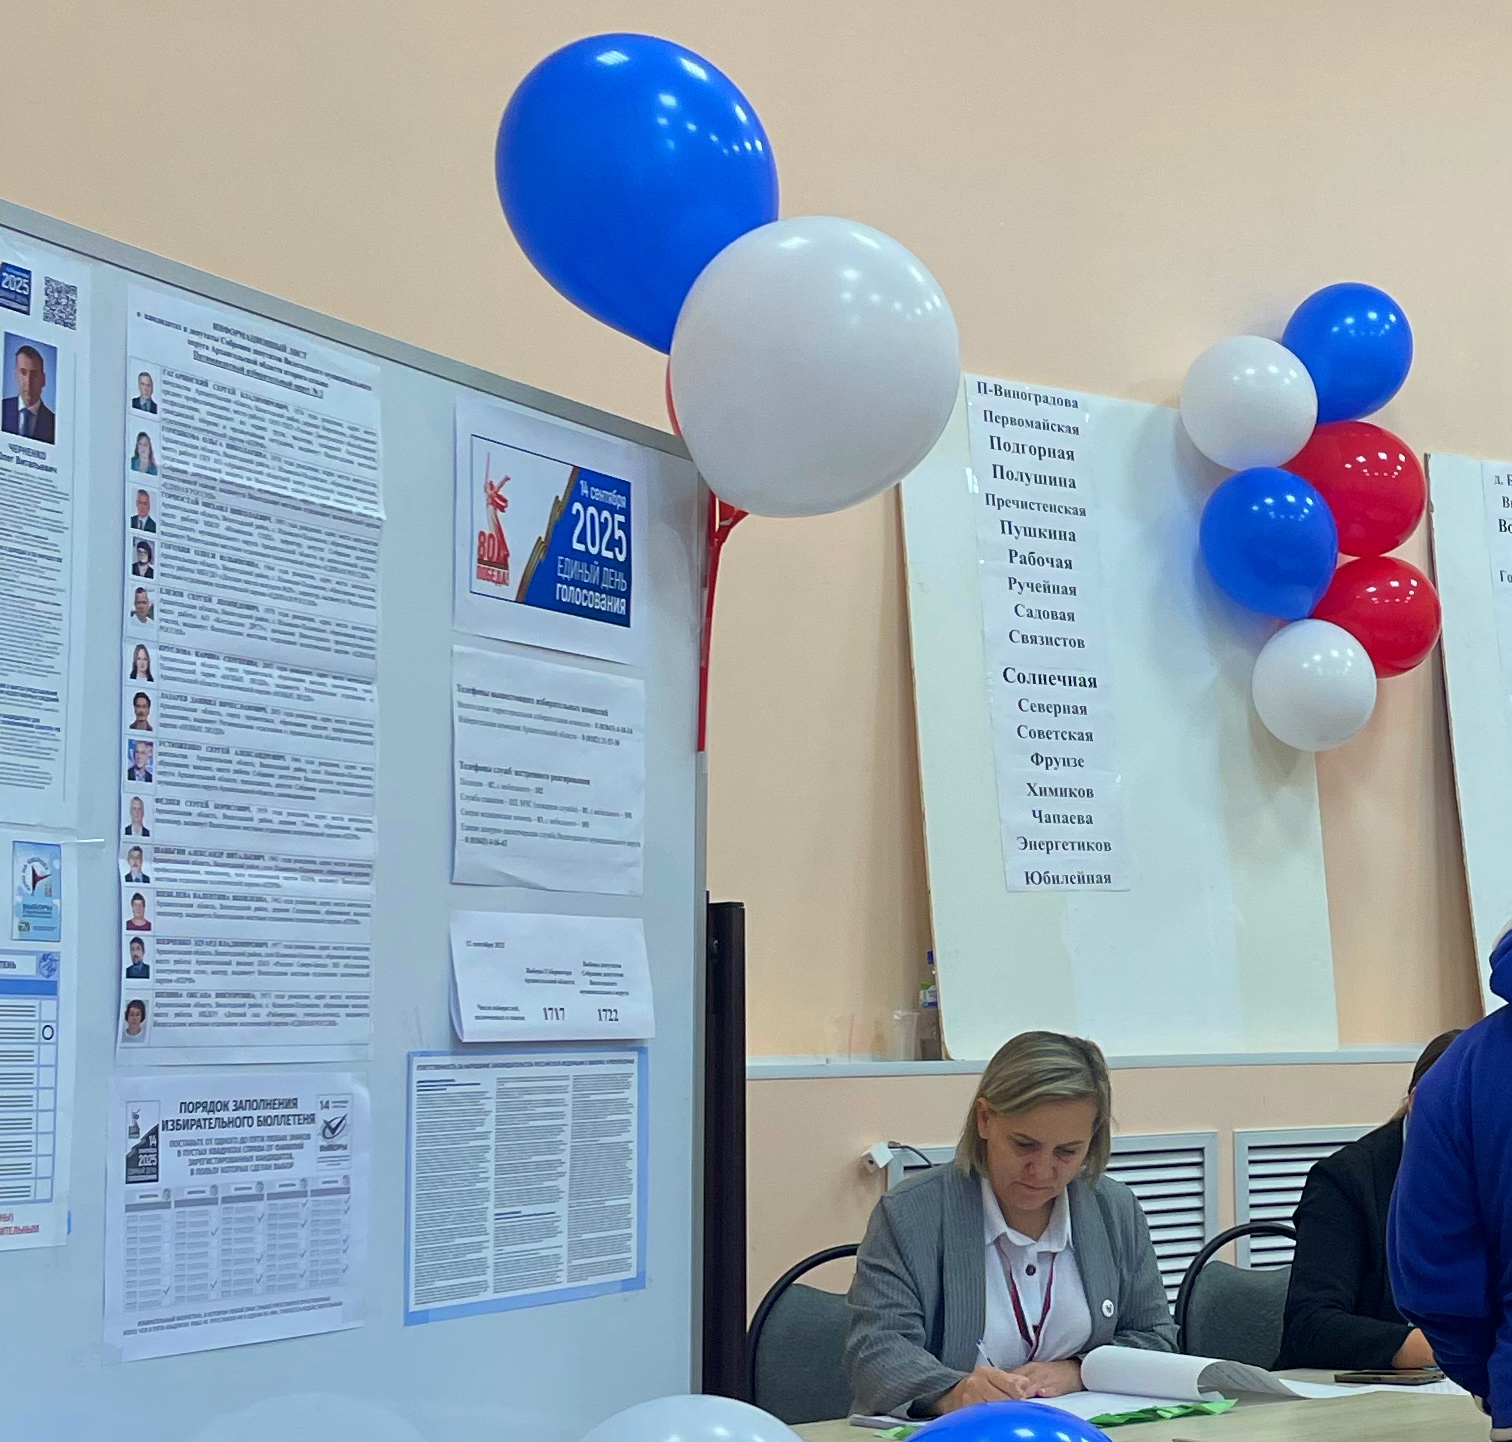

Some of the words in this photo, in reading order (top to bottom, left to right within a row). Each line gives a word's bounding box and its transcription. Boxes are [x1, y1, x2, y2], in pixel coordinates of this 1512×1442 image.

[2, 272, 29, 295] 2025
[977, 381, 1079, 409] П-Виноградова
[983, 410, 1080, 436] Первомайская
[989, 435, 1075, 461] Подгорная
[992, 464, 1077, 489] Полушина
[580, 480, 588, 497] 14
[590, 487, 627, 511] сентября
[985, 493, 1087, 518] Пречистенская
[571, 501, 627, 562] 2025
[1000, 519, 1077, 543] Пушкина
[1008, 549, 1073, 570] Рабочая
[556, 555, 600, 584] ЕДИНЫЙ
[601, 566, 628, 592] ДЕНЬ
[1008, 576, 1077, 597] Ручейная
[1014, 603, 1076, 623] Садовая
[1008, 629, 1086, 649] Связистов
[1002, 666, 1098, 688] Солнечная
[1017, 697, 1088, 718] Северная
[1016, 724, 1094, 742] Советская
[1030, 752, 1085, 771] Фрунзе
[1026, 782, 1095, 799] Химиков
[1032, 809, 1094, 825] Чапаева
[1016, 836, 1112, 855] Энергетиков
[1024, 870, 1112, 886] Юбилейная
[543, 1006, 566, 1021] 1717
[597, 1007, 620, 1022] 1722
[179, 1099, 230, 1115] ПОРЯДОК
[231, 1097, 298, 1112] ЗАПОЛНЕНИЯ
[319, 1100, 330, 1110] 14
[161, 1116, 255, 1132] ИЗБИРАТЕЛЬНОГО
[257, 1113, 316, 1127] БЮЛЛЕТЕНЯ
[138, 1154, 157, 1167] 2025
